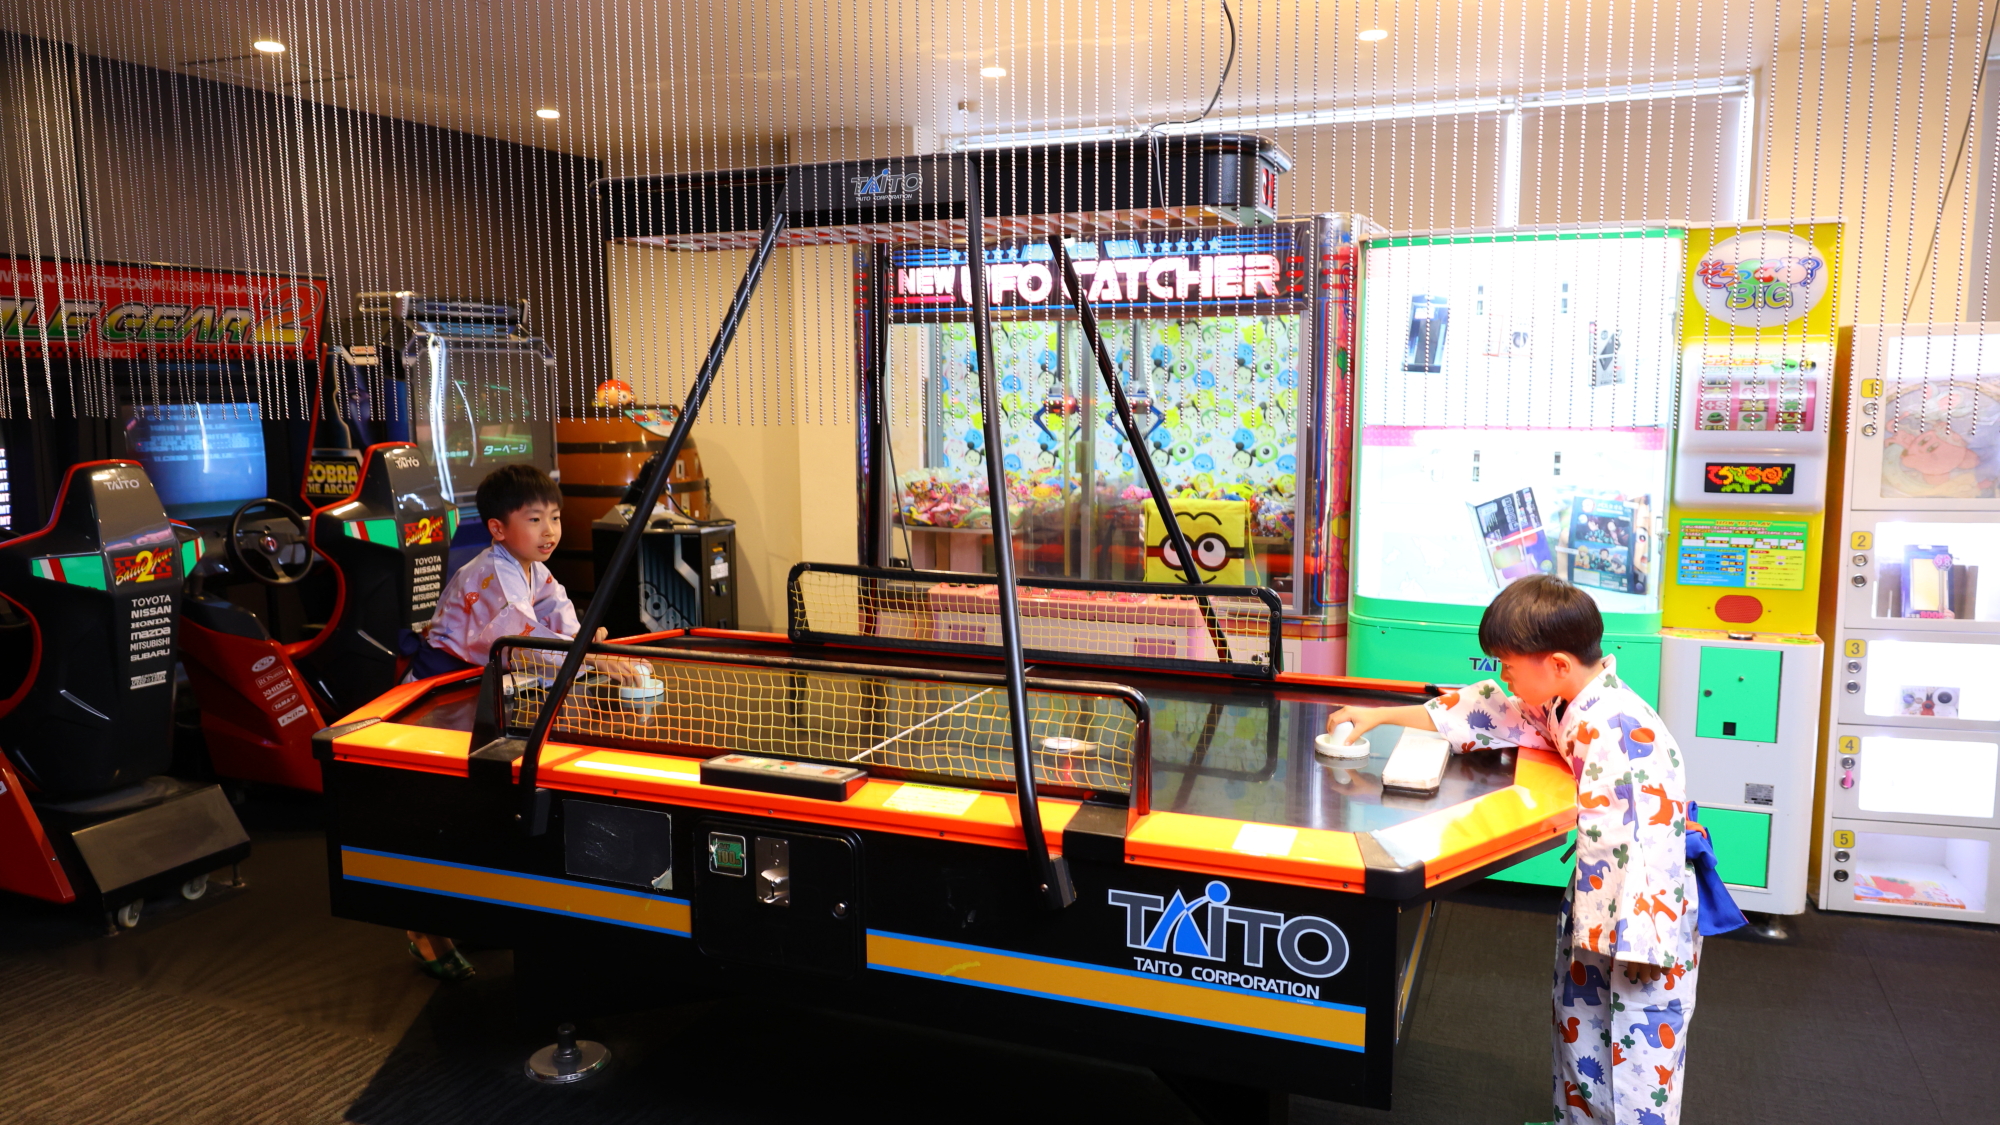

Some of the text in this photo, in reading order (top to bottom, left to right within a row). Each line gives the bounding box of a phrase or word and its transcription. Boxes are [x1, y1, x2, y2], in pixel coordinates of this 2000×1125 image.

[851, 168, 923, 195] TAITO
[874, 193, 913, 201] CORPORATION
[152, 277, 210, 293] MITSUBISHI
[898, 253, 1281, 304] NEW UFO CATCHER
[1726, 282, 1793, 310] BIG
[101, 301, 250, 344] GEAR
[248, 281, 322, 345] 2
[395, 456, 420, 469] TAITO
[307, 463, 359, 484] COBRA
[104, 477, 140, 491] TAITO
[324, 483, 355, 495] ARCAD
[418, 517, 432, 545] 2
[1857, 535, 1867, 547] 2
[135, 550, 155, 583] 2
[414, 555, 442, 566] TOYOTA
[414, 564, 442, 575] NISSAN
[413, 573, 441, 584] HONDA
[131, 594, 172, 608] TOYOTA
[412, 591, 440, 602] MITSUBISHI
[131, 604, 172, 619] NISSAN
[130, 617, 171, 629] HONDA
[130, 637, 170, 651] MITSUBISHI
[1851, 642, 1860, 655] 3
[130, 648, 170, 662] SUBARU
[1845, 740, 1854, 751] 4
[1840, 833, 1849, 845] 5
[1108, 880, 1349, 979] TAITO
[1133, 956, 1320, 1000] TAITO CORPORATION
